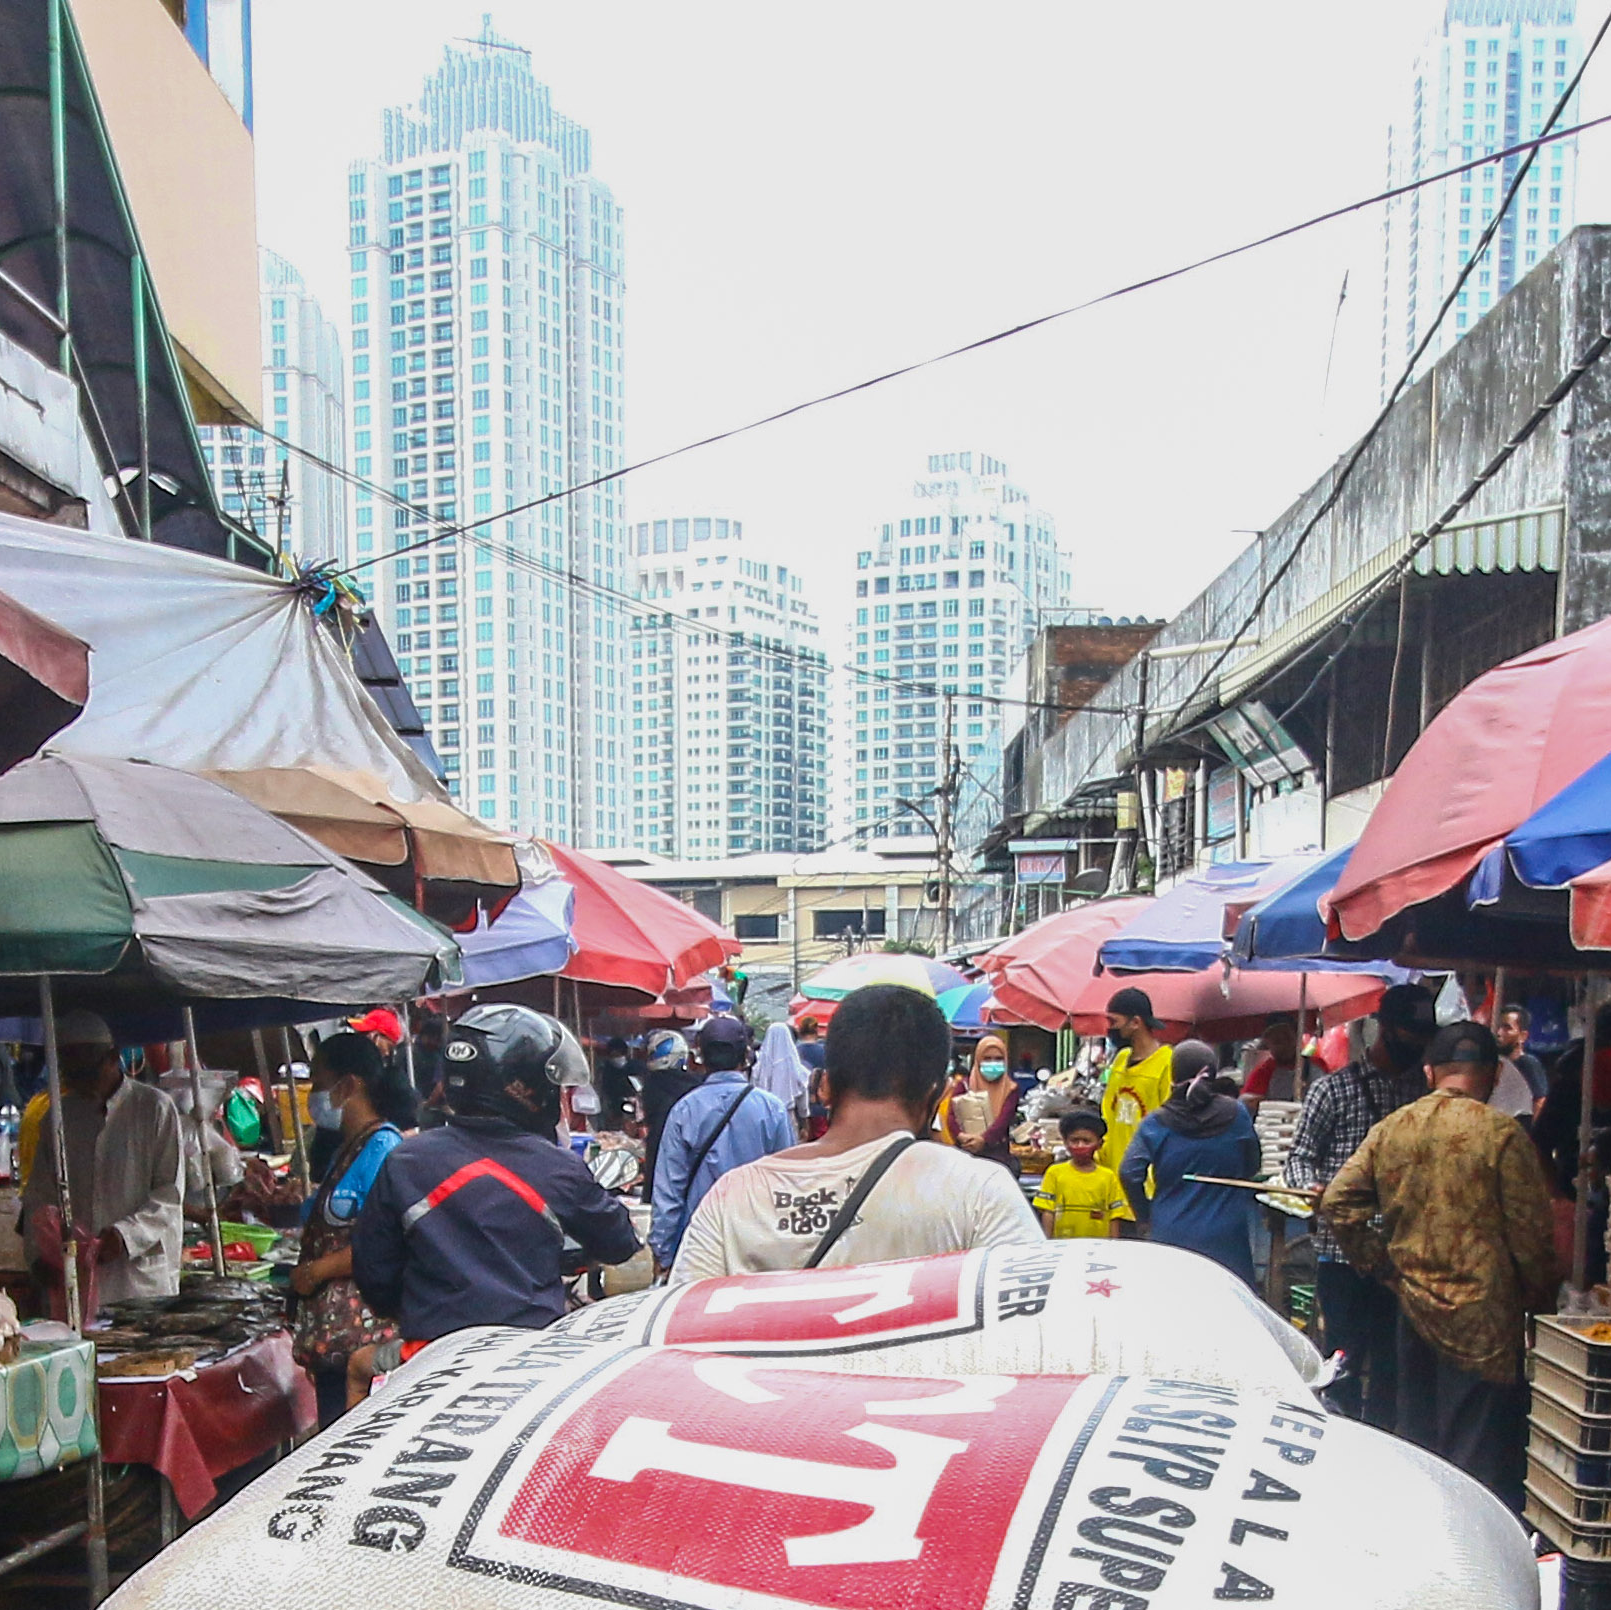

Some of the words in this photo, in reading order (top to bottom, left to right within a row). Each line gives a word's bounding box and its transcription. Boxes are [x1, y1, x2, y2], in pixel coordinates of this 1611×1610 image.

[773, 1187, 838, 1208] Back
[267, 1366, 474, 1542] KARAWANG
[348, 1378, 546, 1553] TERANG
[1108, 1403, 1239, 1491] SLYP
